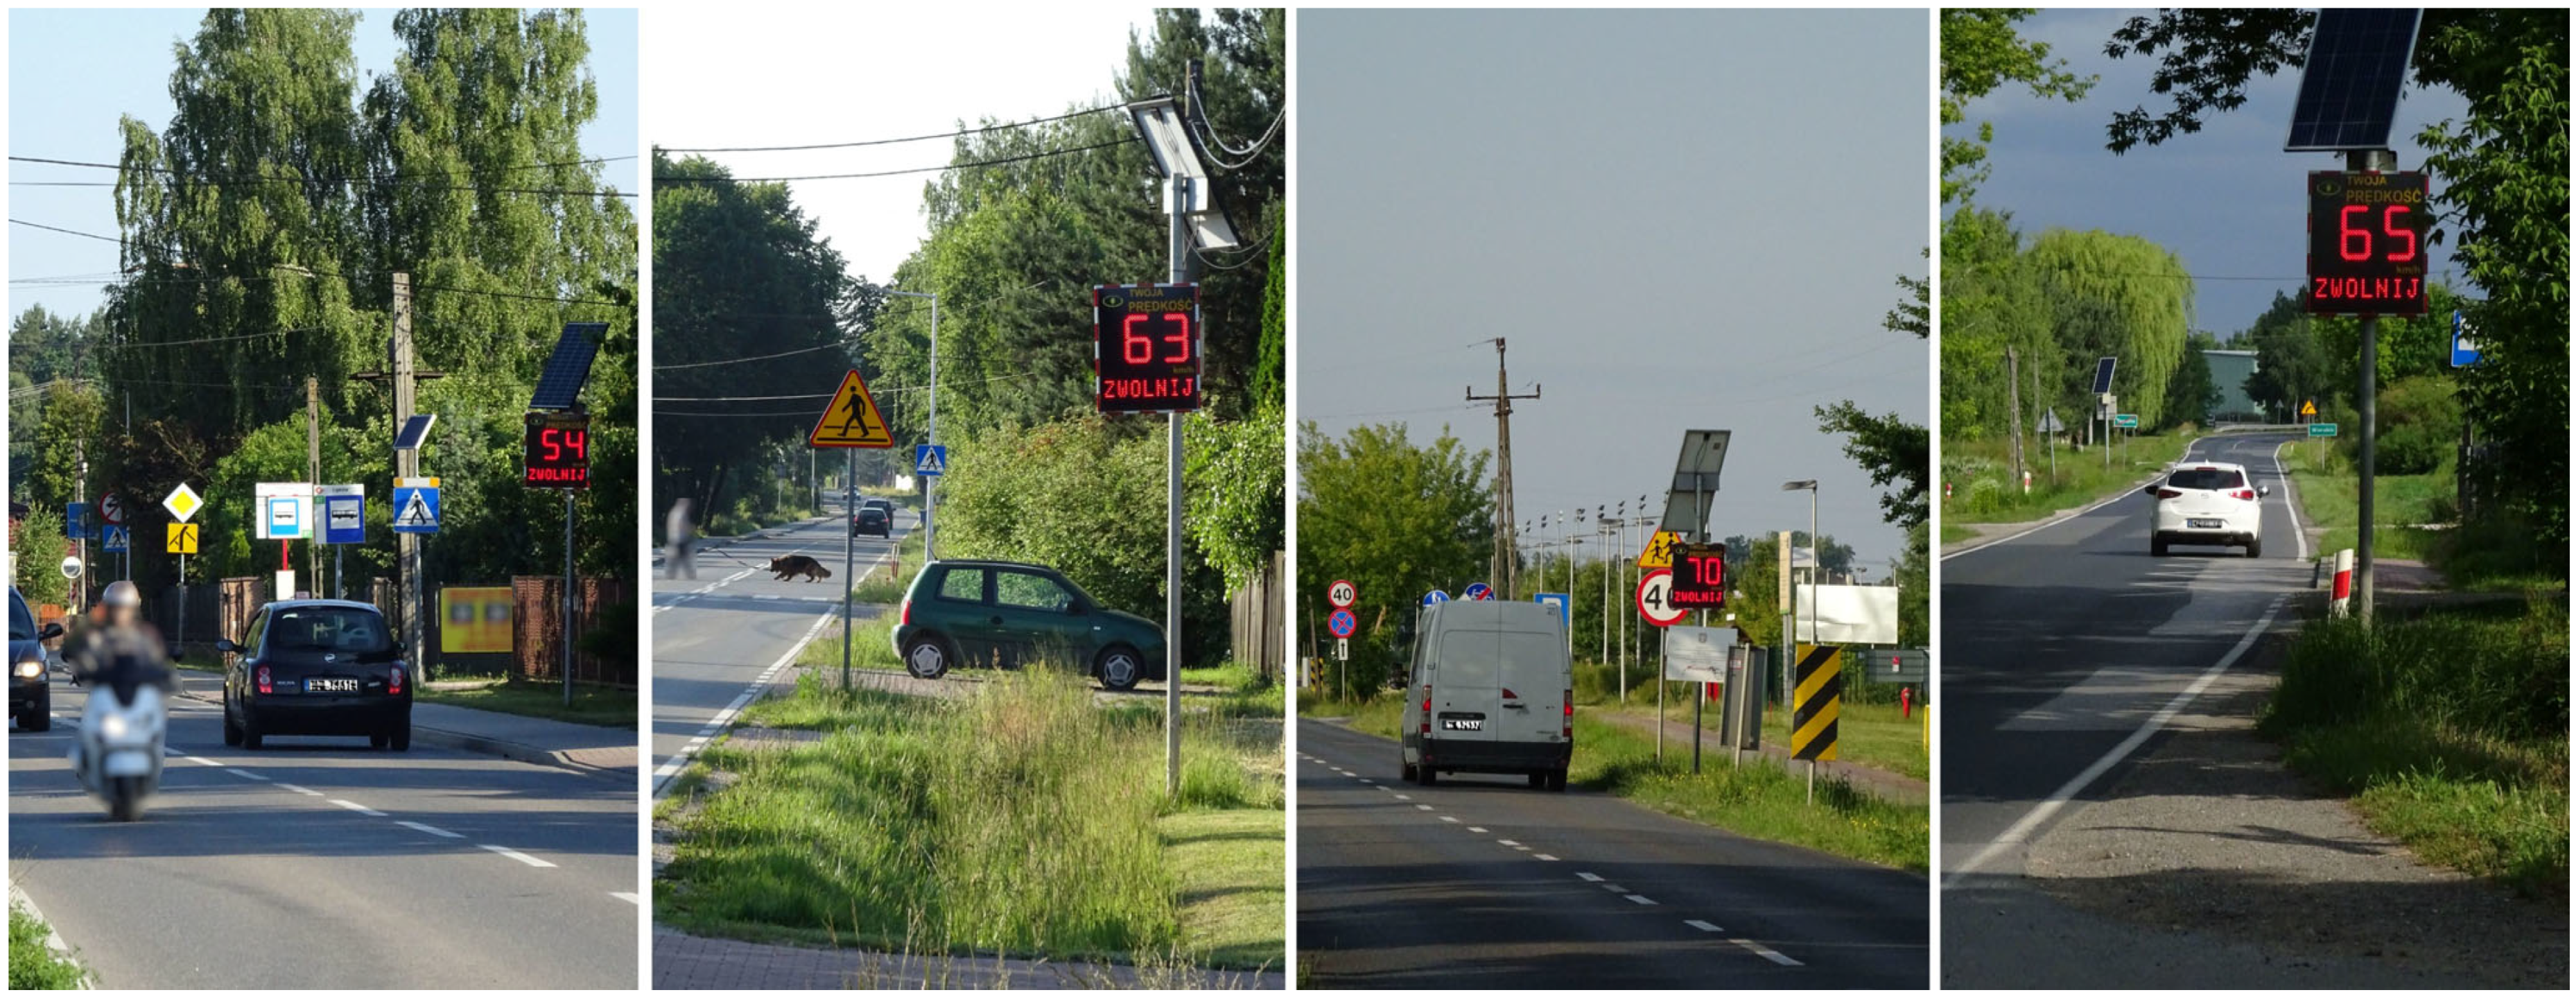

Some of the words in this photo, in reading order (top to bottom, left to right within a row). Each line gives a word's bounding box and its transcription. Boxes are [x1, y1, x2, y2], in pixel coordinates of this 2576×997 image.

[2347, 175, 2387, 187] TWOJA
[2346, 187, 2422, 204] PRĘDKOŚĆ
[2340, 205, 2416, 262] 65
[1129, 288, 1164, 297] TWOJA
[2315, 277, 2419, 299] ZWOLNIJ
[1129, 298, 1192, 313] PRĘDKOŚĆ
[1122, 313, 1190, 364] 63
[1104, 378, 1193, 399] ZWOLNIJ
[541, 428, 584, 461] 54
[528, 467, 585, 481] ZWOLNIJ
[1687, 556, 1721, 586] 70
[1333, 587, 1352, 601] 40
[1644, 584, 1678, 611] 4
[1673, 590, 1723, 602] ZWOLNIJ
